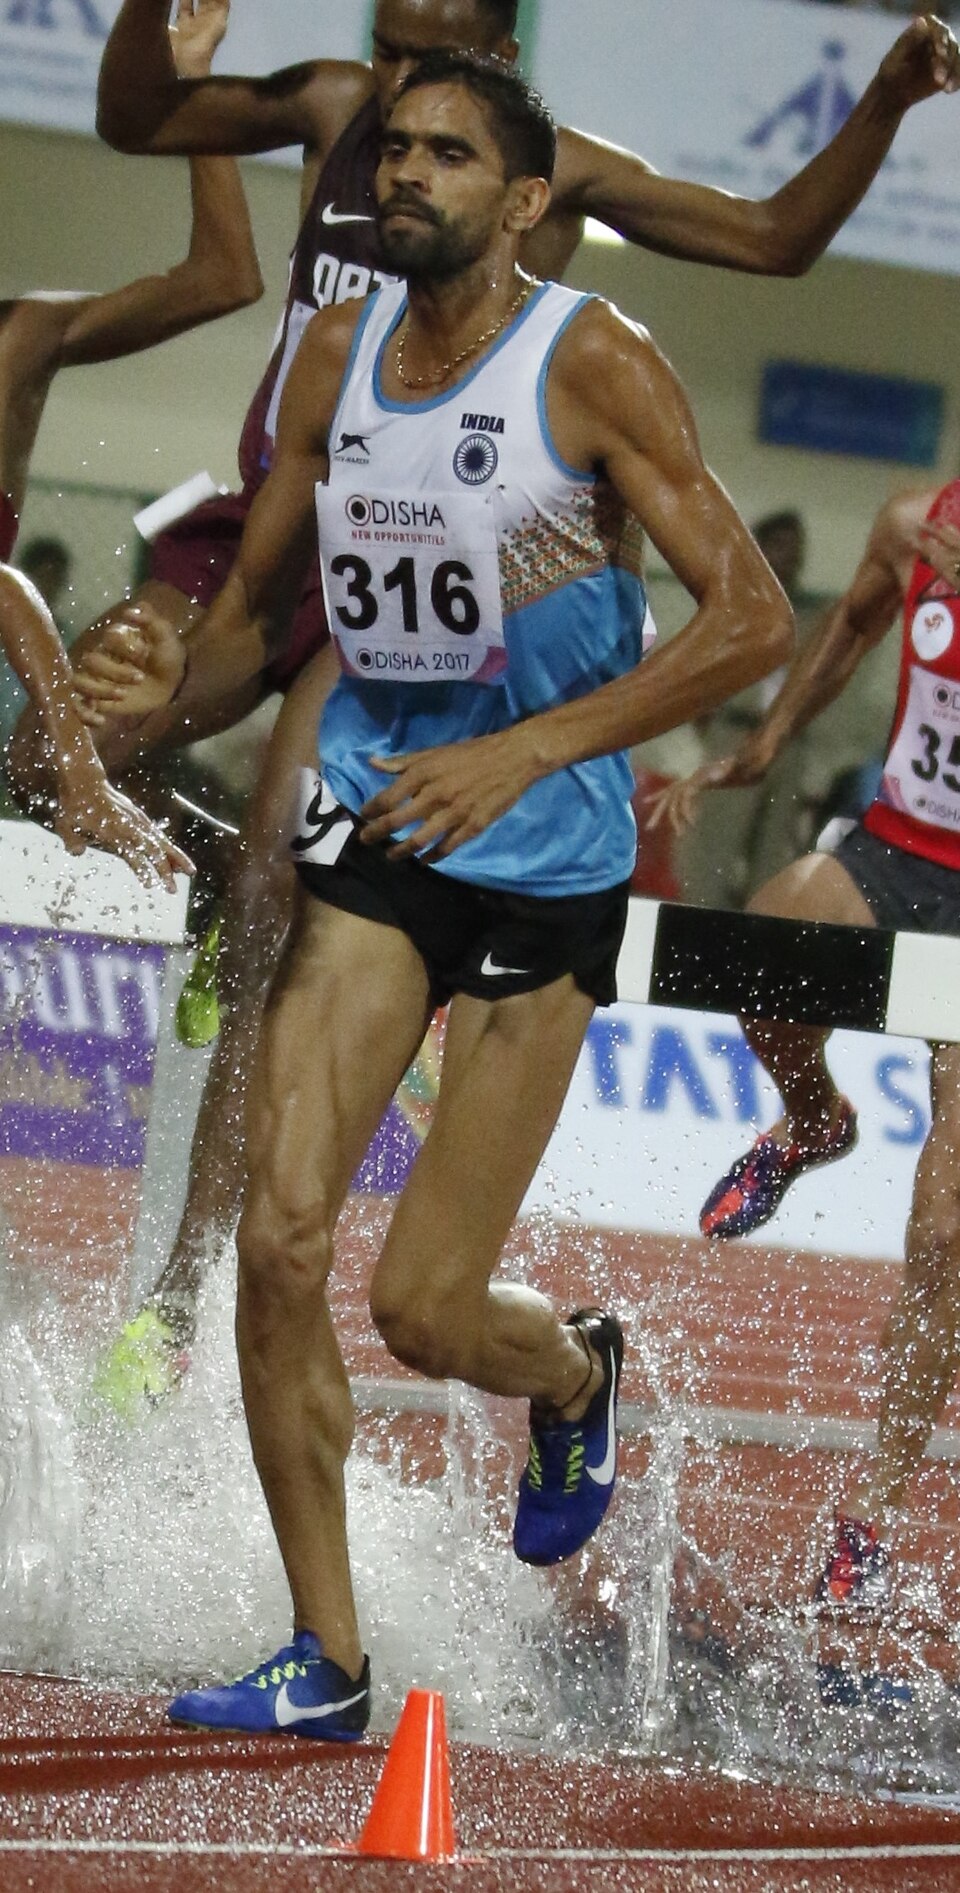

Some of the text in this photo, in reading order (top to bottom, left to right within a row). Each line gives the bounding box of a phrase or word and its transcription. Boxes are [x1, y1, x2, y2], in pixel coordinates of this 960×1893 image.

[460, 413, 505, 434] INDIA
[345, 494, 446, 528] ODISHA
[351, 530, 446, 546] NEW OPPORTUNITIES
[331, 554, 480, 635] 316
[357, 648, 470, 671] ODISHA 2017
[585, 1016, 785, 1124] TAT
